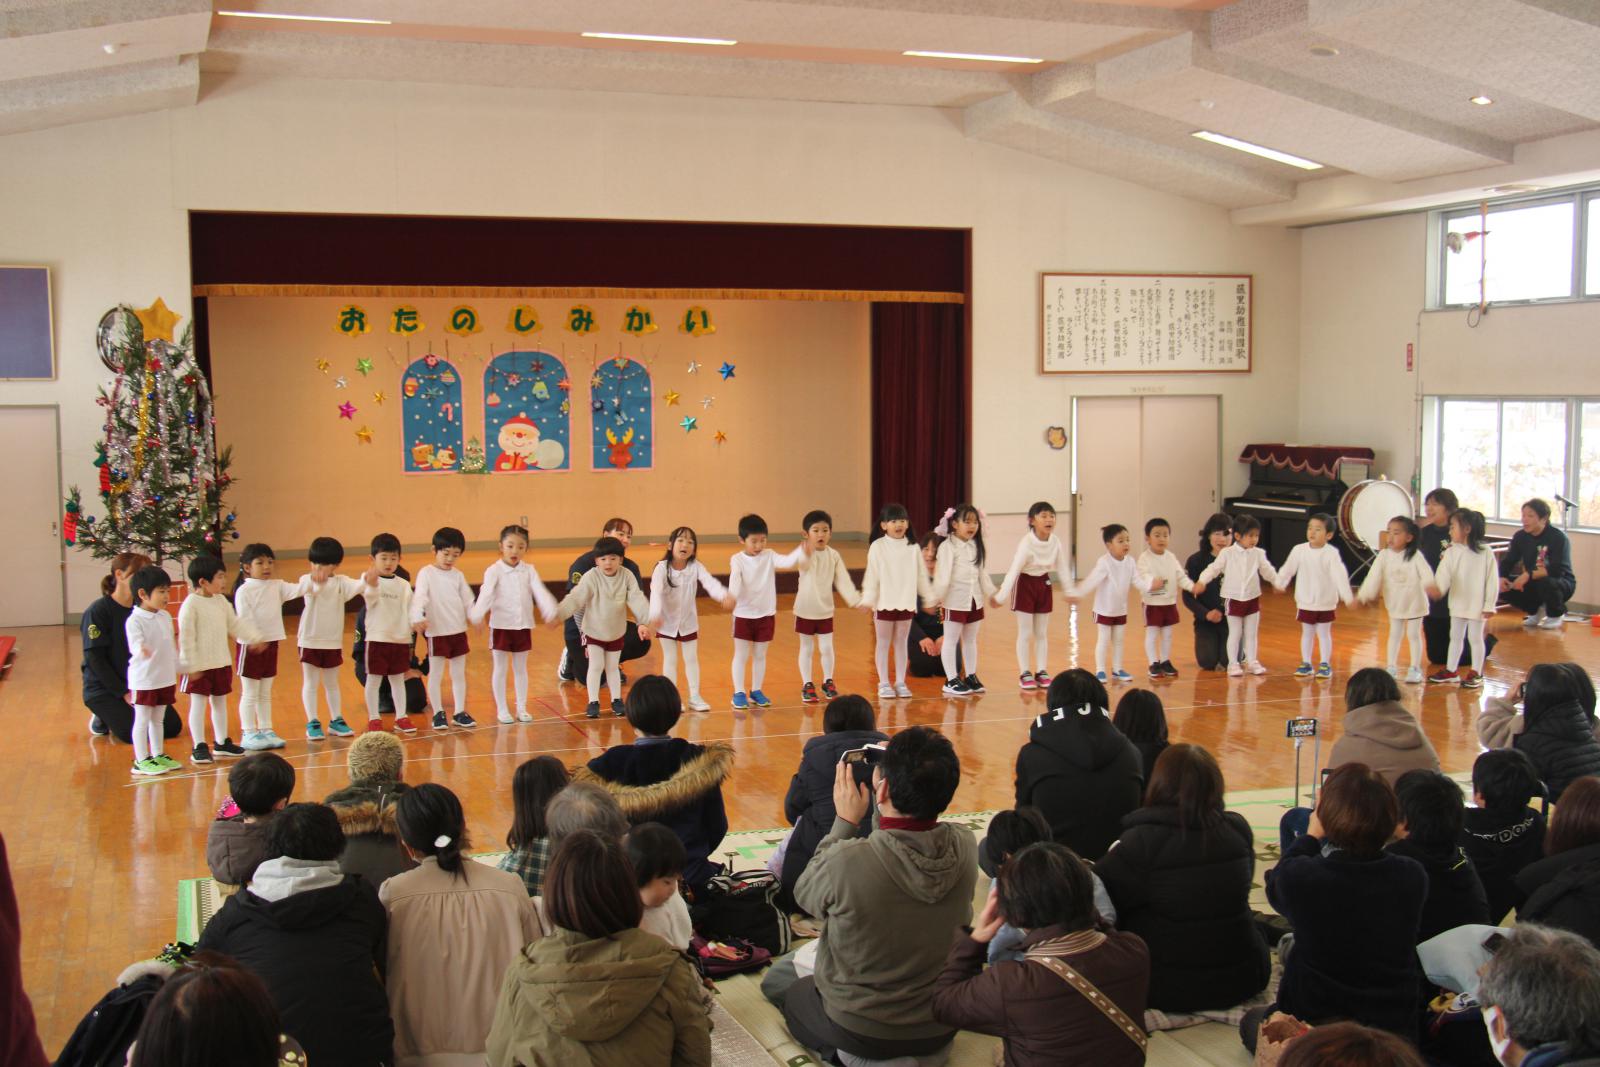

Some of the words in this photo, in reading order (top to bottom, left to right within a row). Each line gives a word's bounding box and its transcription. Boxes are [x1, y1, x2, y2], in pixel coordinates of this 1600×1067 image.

[340, 307, 709, 333] おたのしみかい
